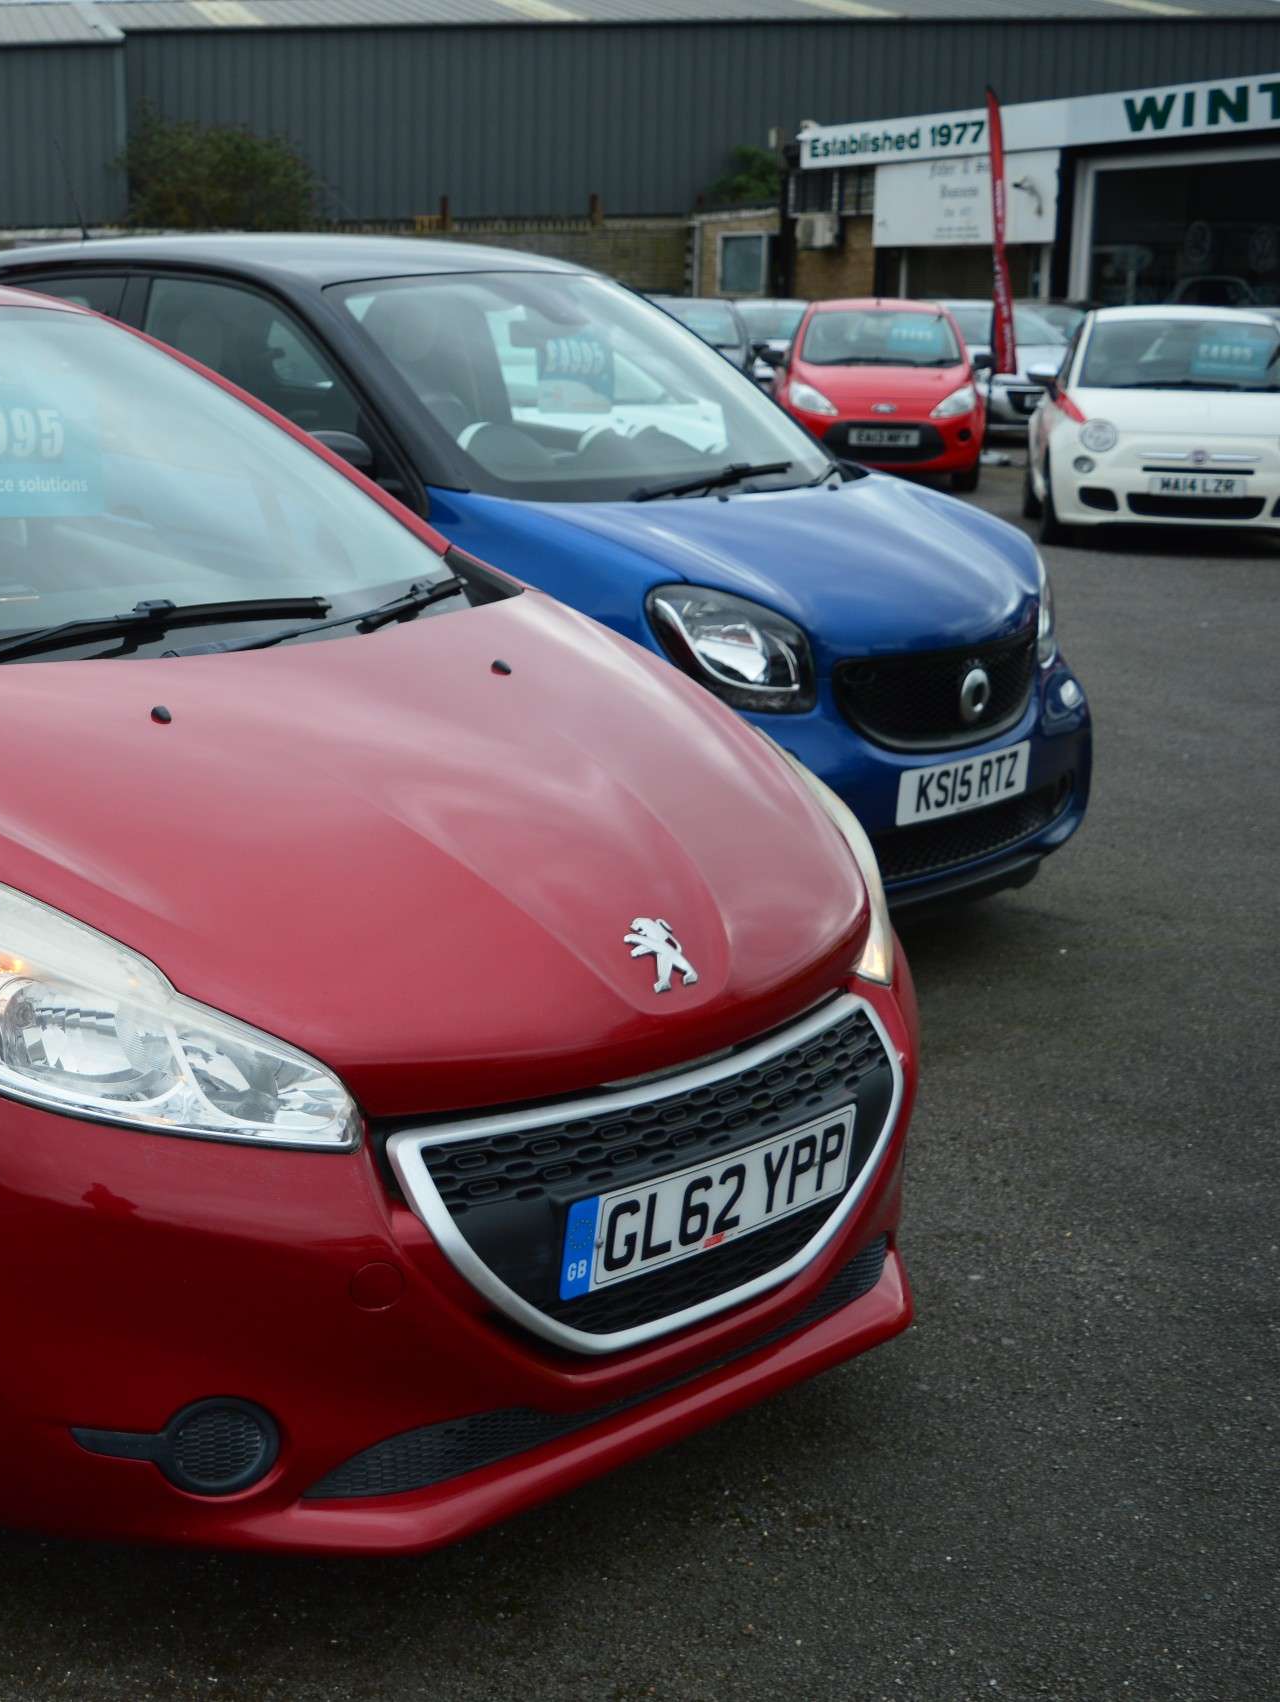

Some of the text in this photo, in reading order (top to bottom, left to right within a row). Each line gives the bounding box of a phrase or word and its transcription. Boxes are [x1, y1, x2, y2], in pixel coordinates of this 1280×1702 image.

[810, 120, 985, 159] Established 1977
[20, 475, 89, 493] solutions
[1161, 477, 1234, 493] MA14 LZR
[915, 751, 1019, 813] KS15 RTZ
[603, 1122, 846, 1272] GL62 YPP
[567, 1259, 587, 1282] GB
